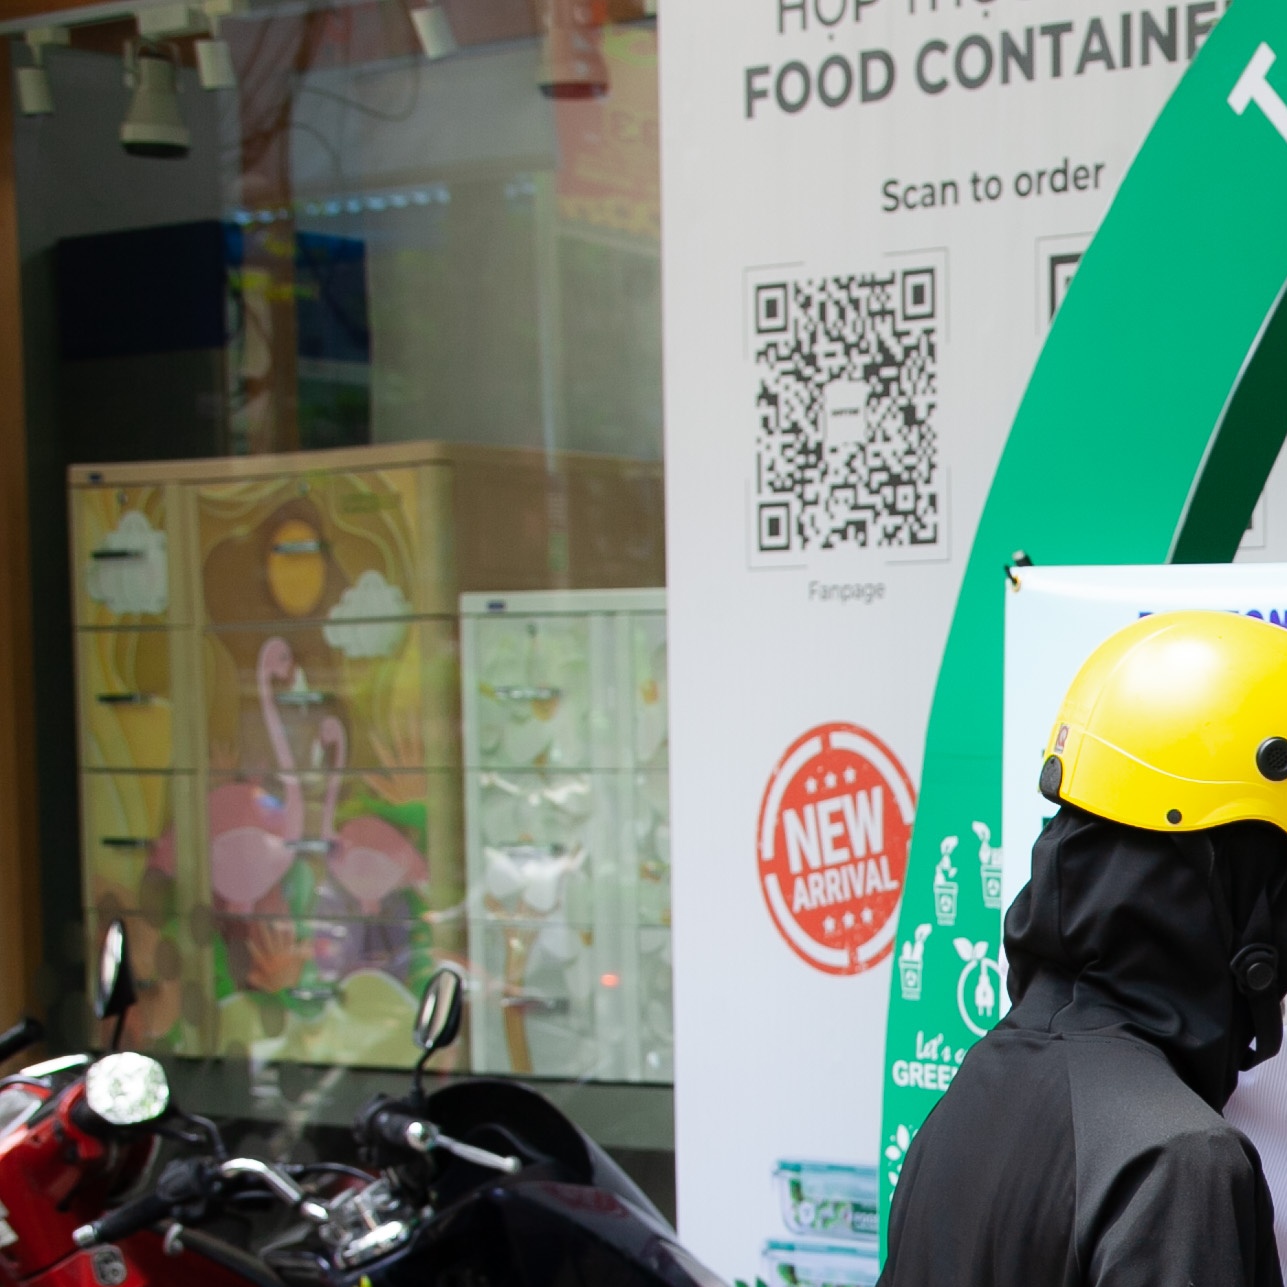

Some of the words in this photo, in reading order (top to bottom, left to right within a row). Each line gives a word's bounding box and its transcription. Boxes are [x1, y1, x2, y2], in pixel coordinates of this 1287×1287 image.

[745, 48, 896, 119] FOOD
[914, 0, 1233, 95] CONTAINE
[881, 177, 960, 212] Scan
[970, 170, 1002, 202] to
[1013, 156, 1105, 198] order
[807, 579, 887, 605] Fanpage
[782, 785, 884, 875] NEW
[791, 854, 900, 914] ARRIVAL
[891, 1058, 961, 1092] GREE
